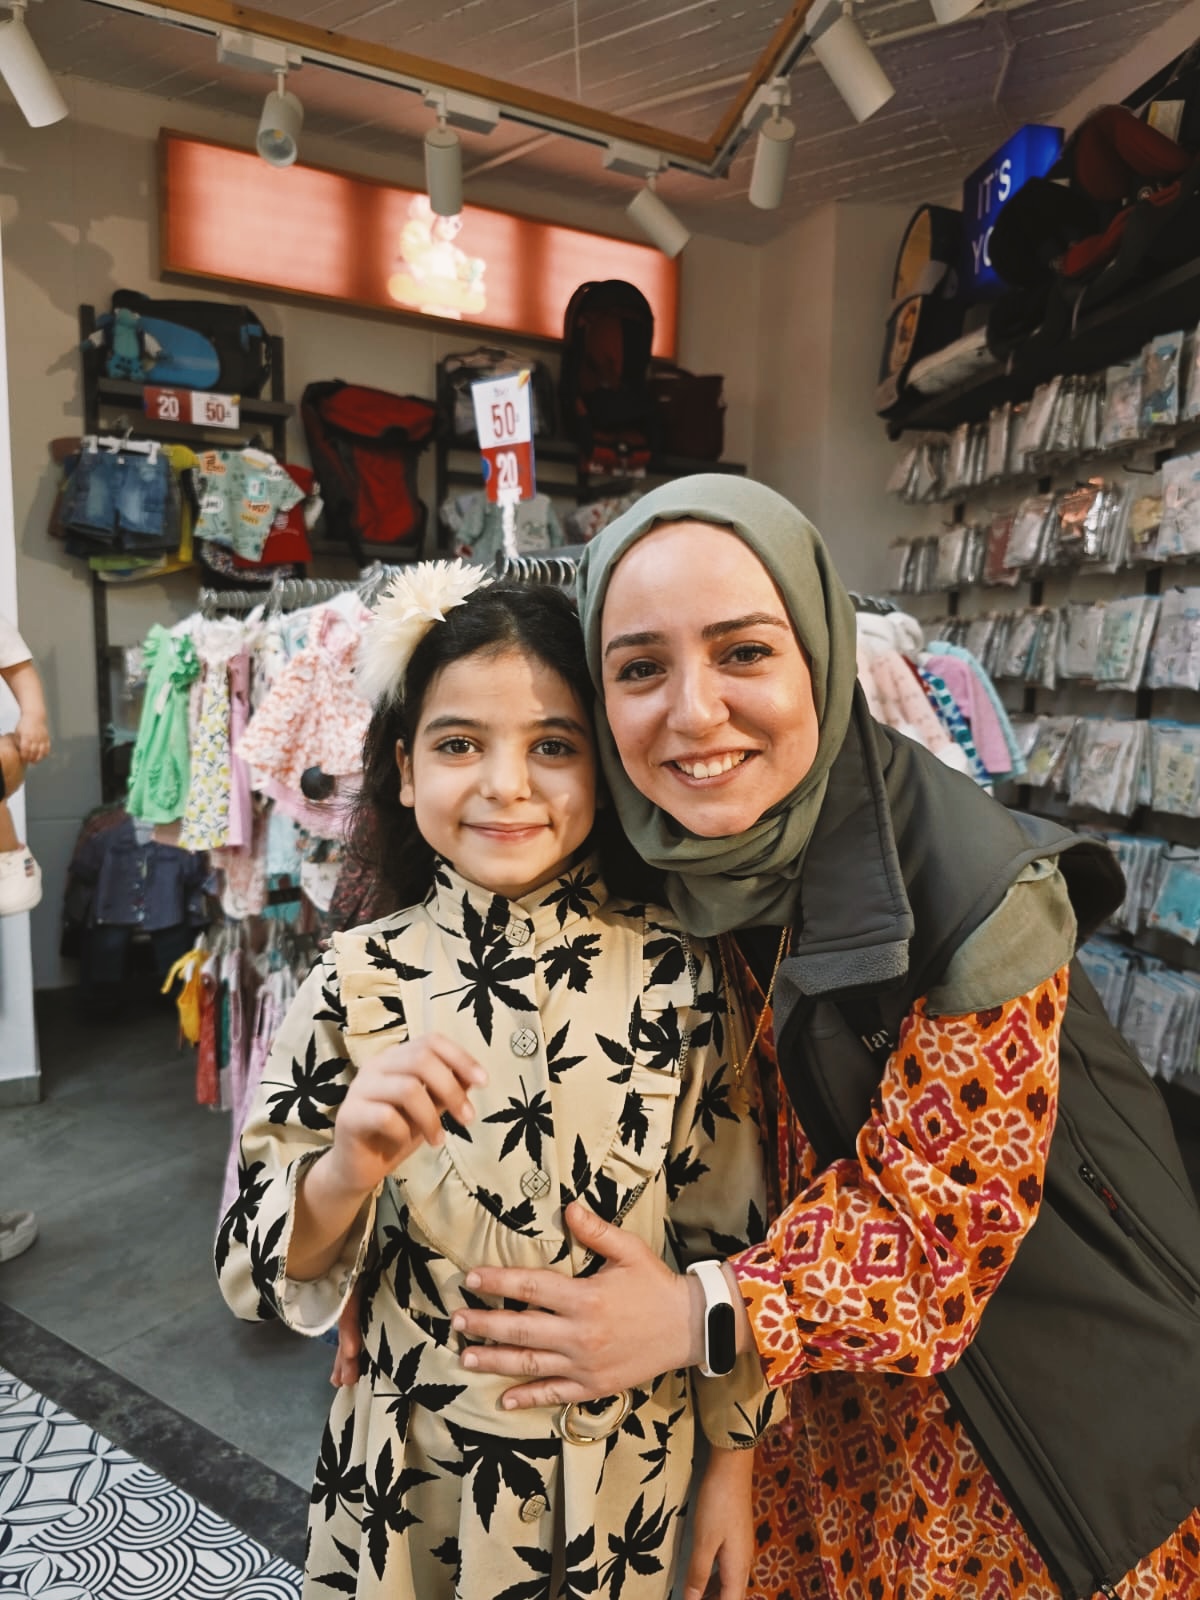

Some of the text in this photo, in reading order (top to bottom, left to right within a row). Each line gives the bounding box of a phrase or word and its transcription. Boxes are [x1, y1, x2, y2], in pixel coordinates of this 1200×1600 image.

[977, 158, 1012, 220] IT'S
[156, 396, 180, 418] 20
[206, 401, 225, 422] 50
[491, 401, 516, 438] 50
[495, 451, 519, 488] 20
